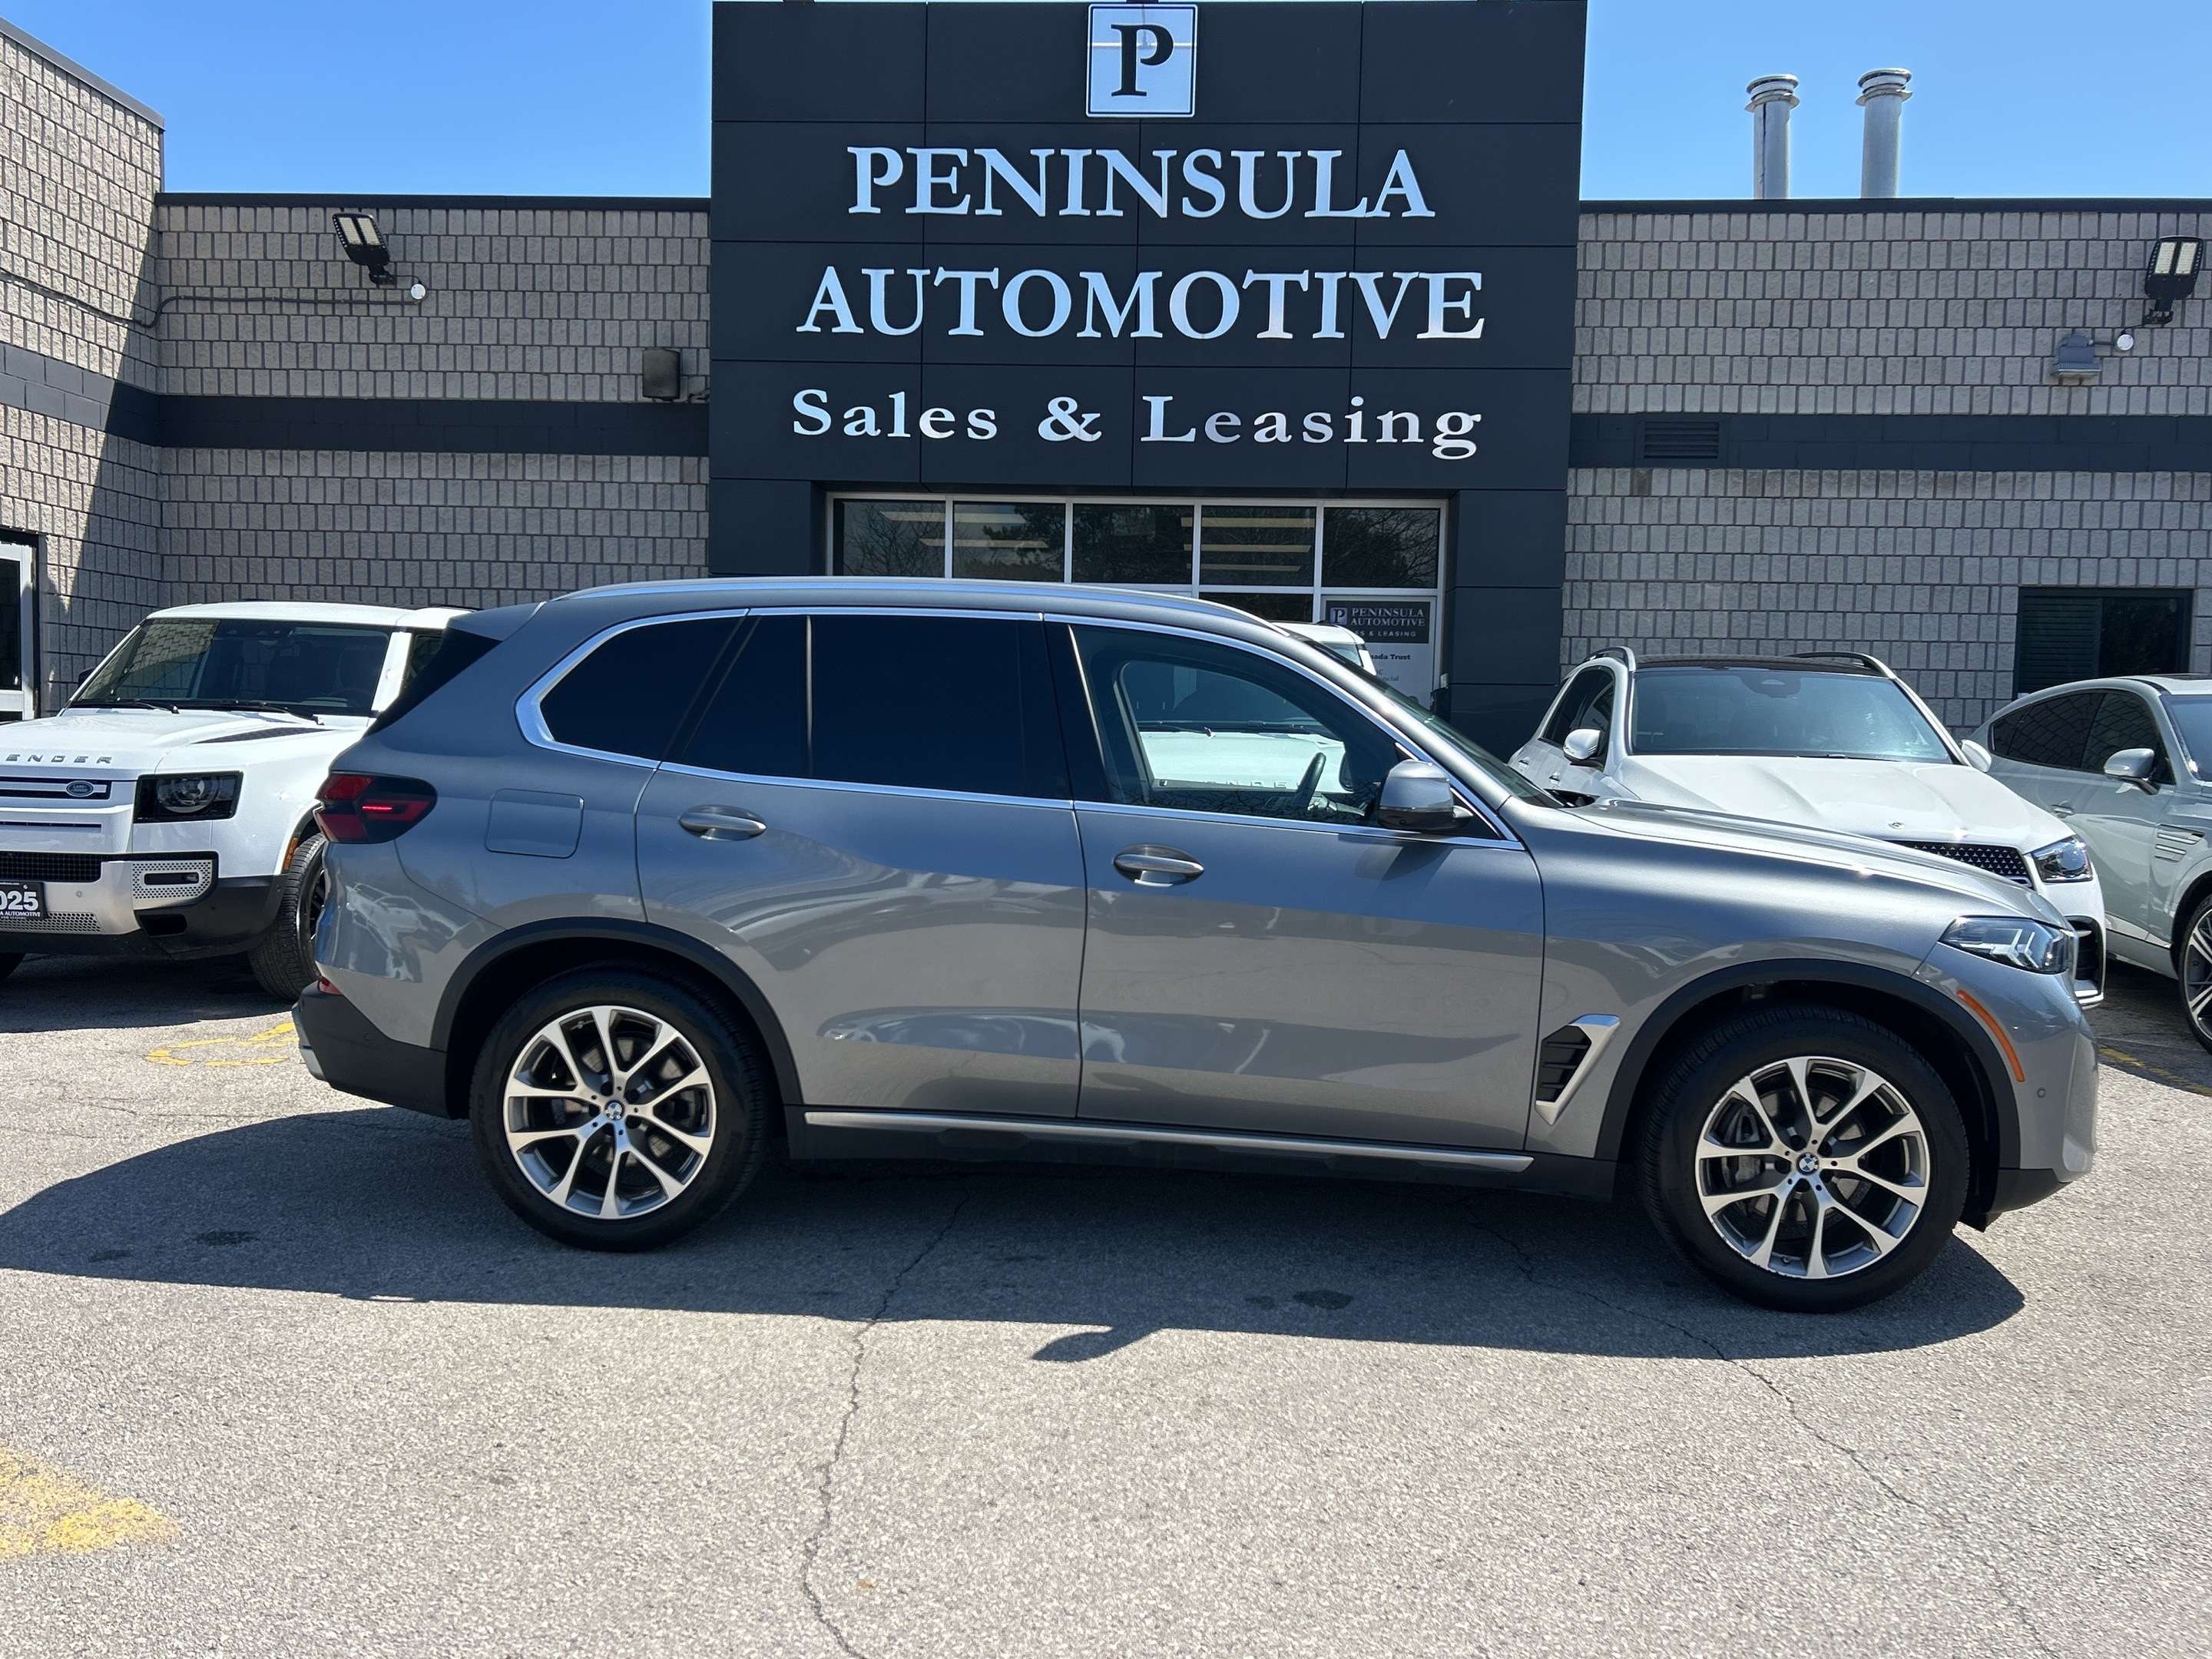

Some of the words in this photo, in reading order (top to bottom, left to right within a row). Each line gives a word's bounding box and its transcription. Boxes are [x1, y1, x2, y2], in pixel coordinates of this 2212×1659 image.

[1111, 24, 1174, 97] P
[846, 146, 1436, 220] PENINSULA
[796, 266, 1485, 339] AUTOMOTIVE
[793, 389, 998, 440] Sales
[1038, 396, 1102, 442] &
[1140, 396, 1482, 460] Leasing
[1333, 609, 1345, 624] P
[1352, 608, 1424, 617] PENINSULA
[1352, 618, 1426, 626] AUTOMOTIVE
